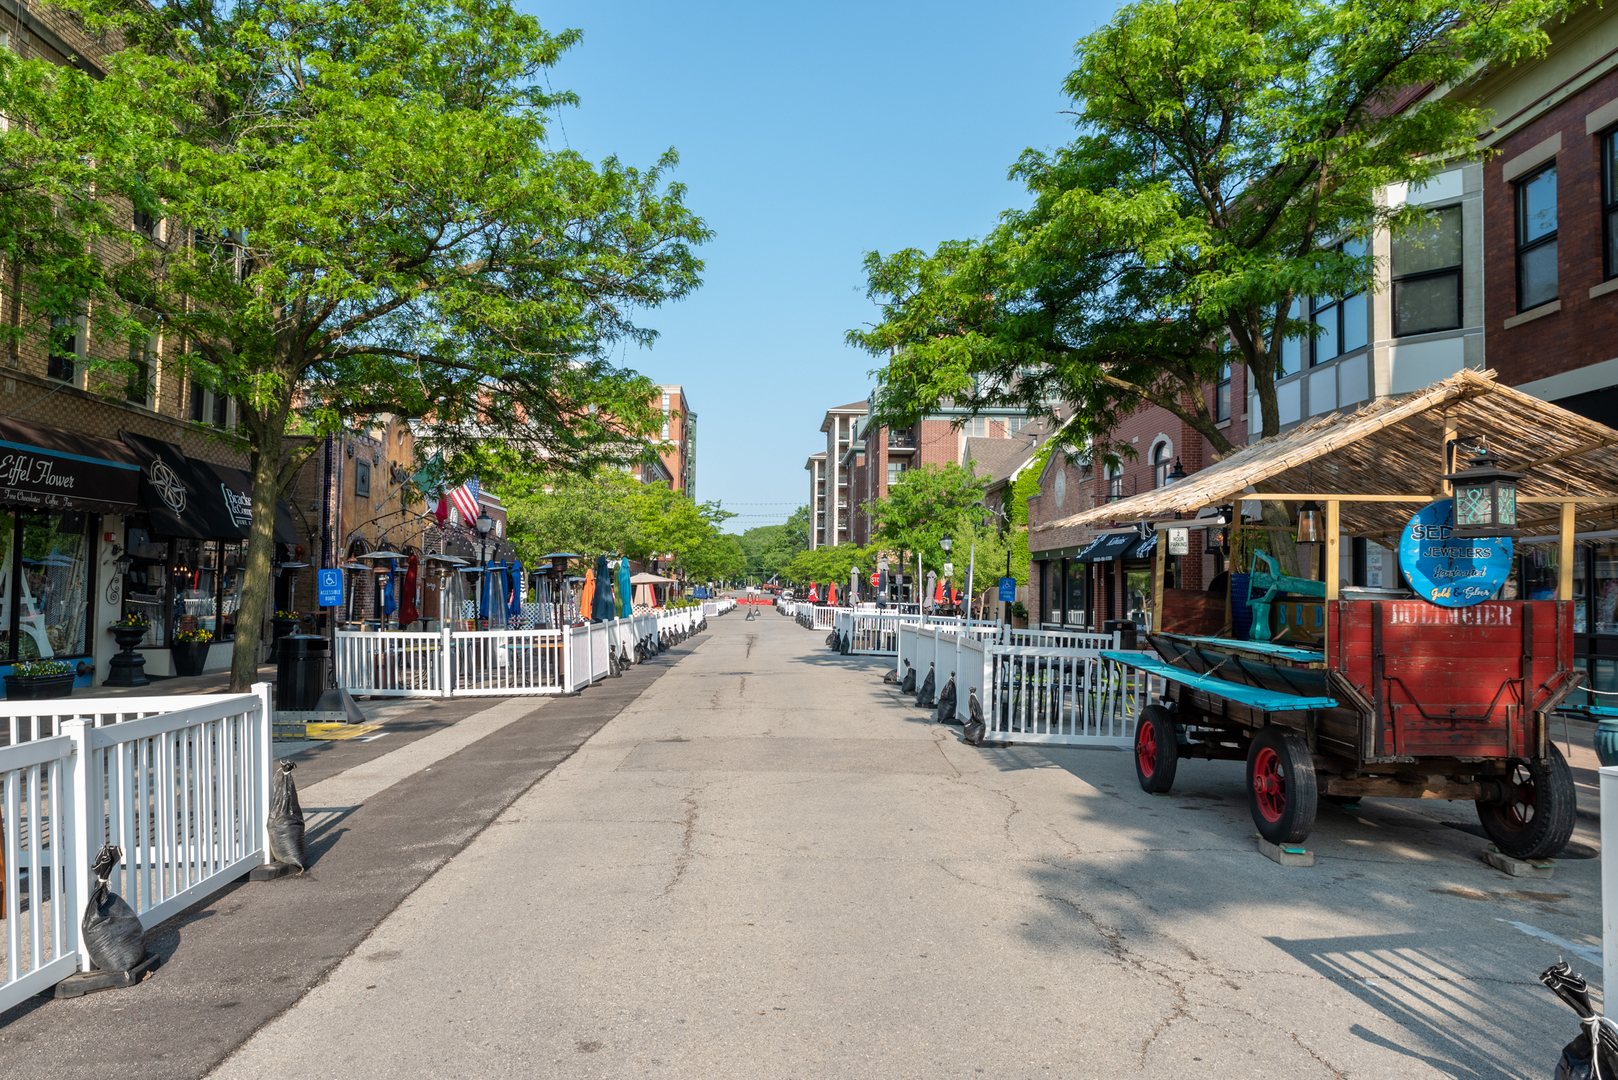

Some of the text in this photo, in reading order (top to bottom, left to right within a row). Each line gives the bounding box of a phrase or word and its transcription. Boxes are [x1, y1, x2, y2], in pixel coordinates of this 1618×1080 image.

[0, 454, 75, 488] Eiffel Flower
[17, 490, 41, 503] Chocolates
[45, 494, 59, 507] Coffee
[225, 488, 252, 506] Bracke
[1423, 546, 1492, 559] JEWELERS
[1433, 565, 1487, 579] Handcrafted
[1431, 586, 1491, 602] Gold & Silver
